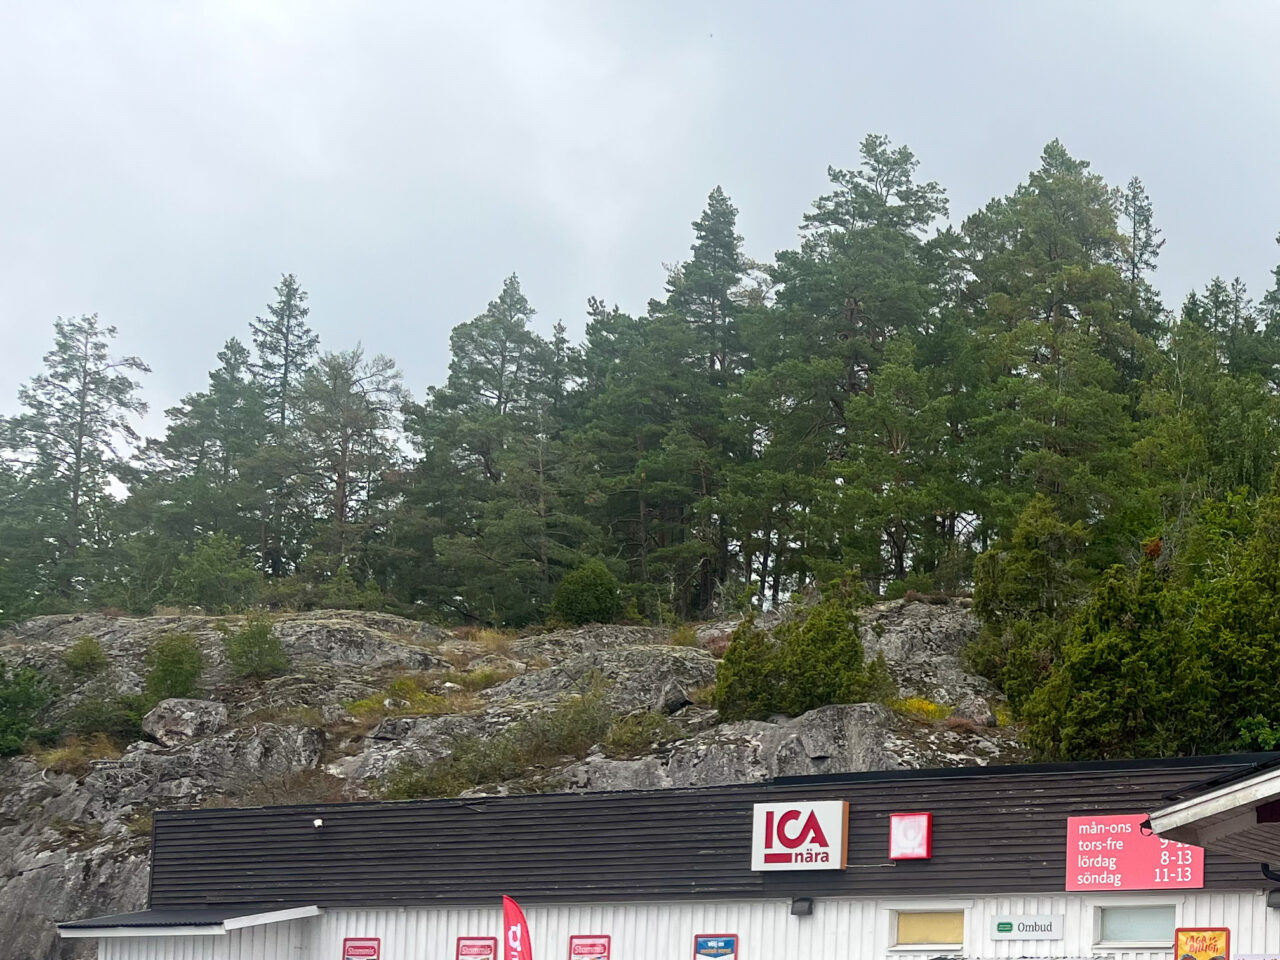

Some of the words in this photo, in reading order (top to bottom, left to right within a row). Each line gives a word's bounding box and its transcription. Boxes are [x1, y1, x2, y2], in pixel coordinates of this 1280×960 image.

[765, 809, 829, 849] ICA
[1078, 821, 1132, 834] mån-ons
[1078, 837, 1124, 851] tors-fre
[1160, 837, 1191, 848] 9-
[794, 849, 829, 863] nära
[1078, 855, 1117, 870] lördag
[1160, 851, 1192, 865] 8-13
[1077, 872, 1122, 886] söndag
[1154, 868, 1192, 882] 11-13
[1017, 921, 1053, 932] Ombud
